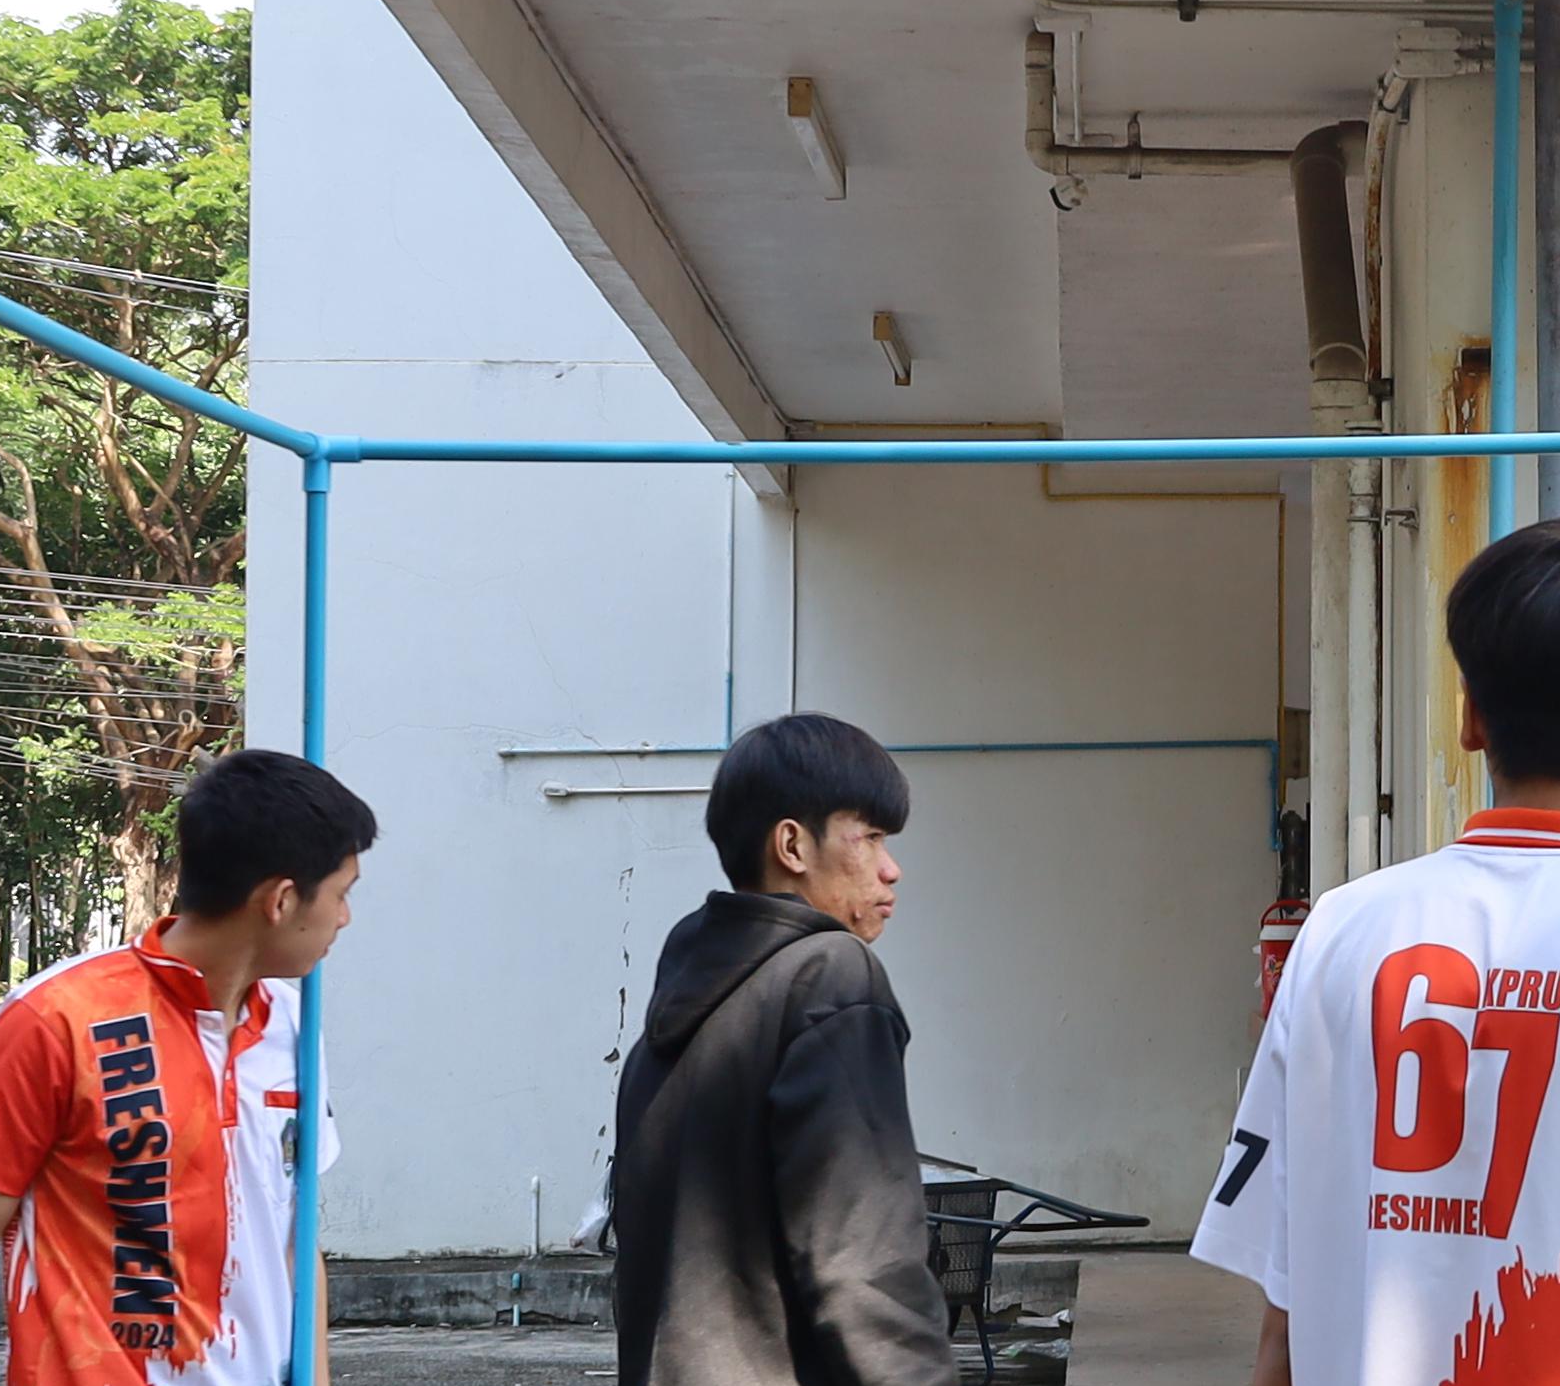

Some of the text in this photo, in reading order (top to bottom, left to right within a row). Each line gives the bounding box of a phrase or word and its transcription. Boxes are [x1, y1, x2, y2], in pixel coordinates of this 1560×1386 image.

[1371, 943, 1560, 1240] 67
[89, 1012, 179, 1317] FRESHMEN
[1213, 1127, 1271, 1208] 7
[1369, 1193, 1487, 1236] ESHME
[111, 1322, 177, 1351] 2024
